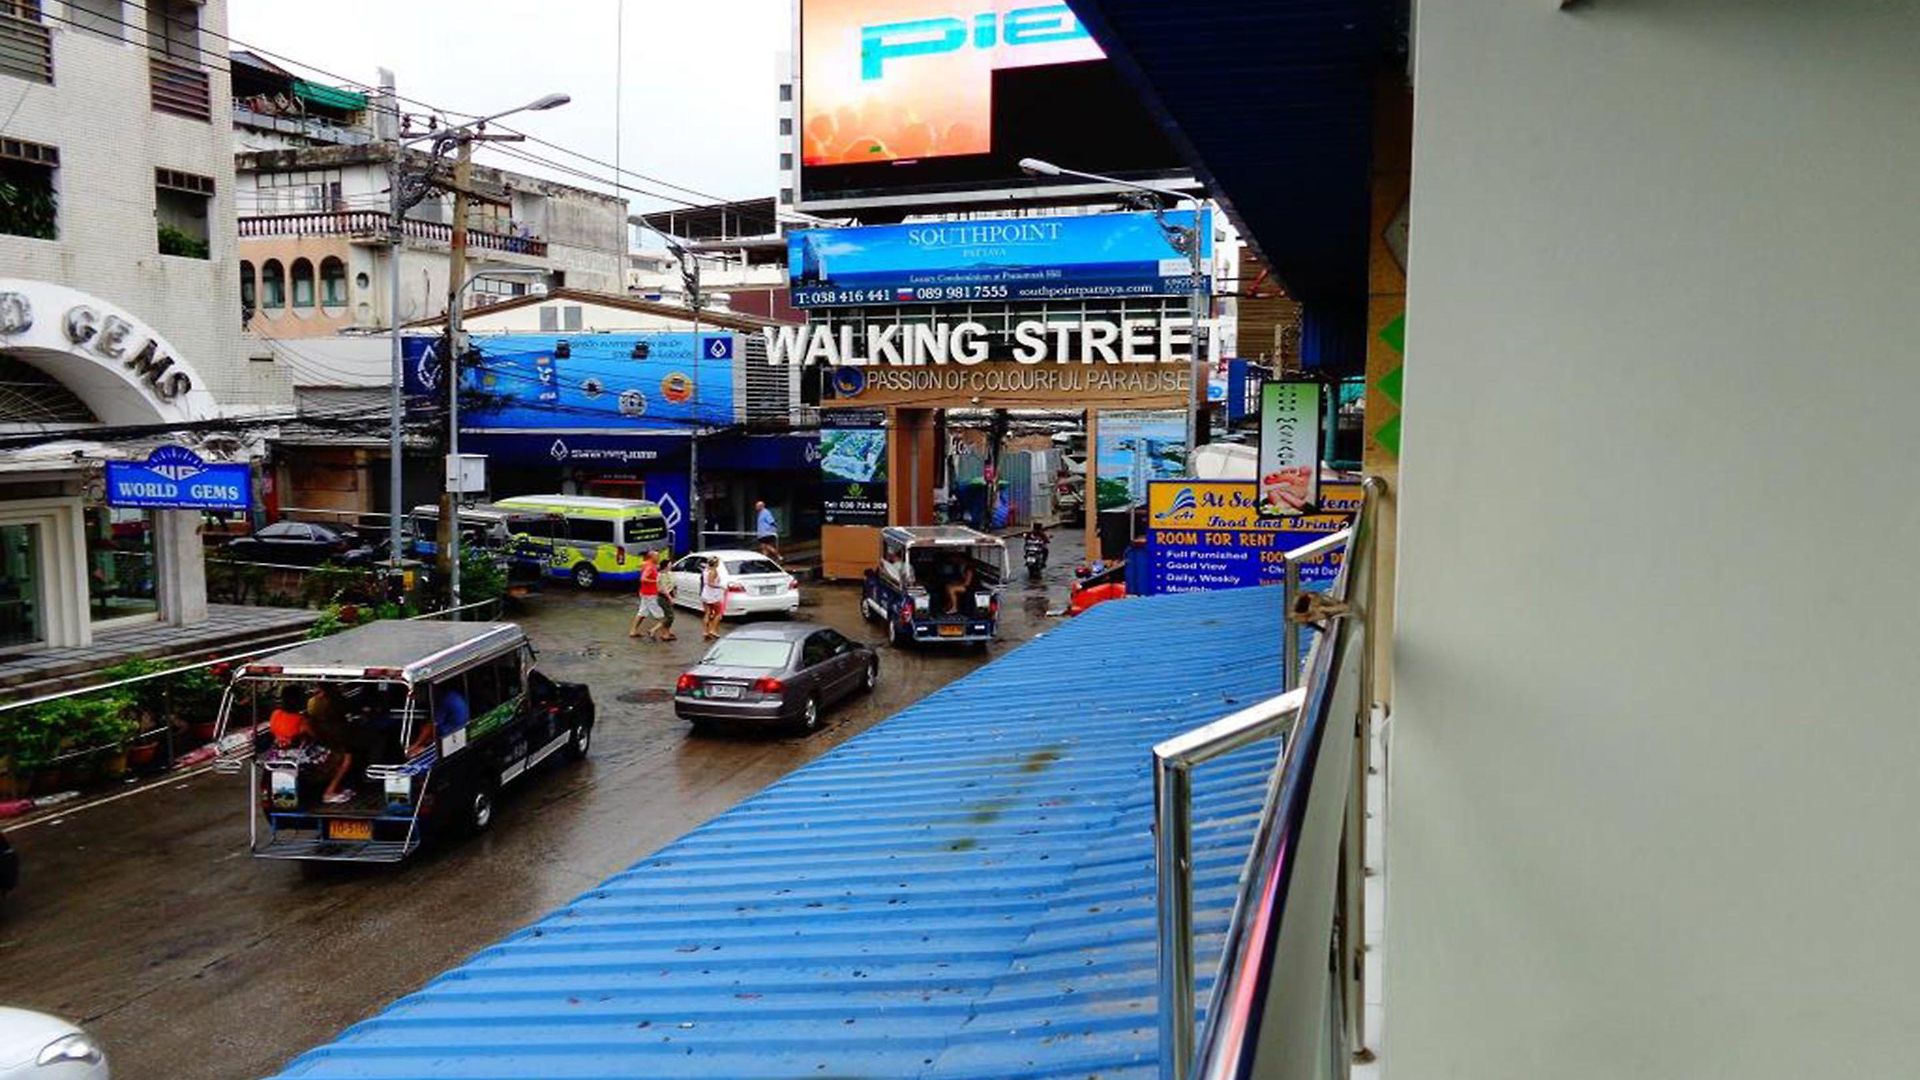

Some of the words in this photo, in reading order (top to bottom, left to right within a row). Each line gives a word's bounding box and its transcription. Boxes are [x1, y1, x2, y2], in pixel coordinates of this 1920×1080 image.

[908, 223, 1062, 246] SOUTHPOINT
[962, 248, 1006, 258] PATTAYA
[811, 291, 836, 304] 038
[839, 289, 864, 302] 416
[867, 289, 890, 301] 441
[916, 286, 942, 300] 089
[946, 286, 970, 299] 981
[974, 284, 1008, 299] 7555
[1019, 283, 1153, 298] southpointpattaya.com
[762, 322, 990, 366] WALKING
[1011, 318, 1222, 365] STREET
[62, 304, 192, 403] GEMS
[866, 370, 942, 390] PASSION
[945, 370, 968, 389] OF
[970, 369, 1082, 391] COLOURFUL
[1086, 369, 1191, 391] PARADISE
[119, 482, 178, 498] WORLD
[190, 484, 240, 501] GEMS
[1200, 490, 1225, 508] At
[1206, 515, 1248, 529] Food
[1253, 517, 1284, 529] and
[1156, 532, 1198, 545] ROOM
[1204, 533, 1232, 546] FOR
[1239, 533, 1275, 547] RENT
[1166, 550, 1187, 559] Full
[1189, 551, 1249, 560] Furnished
[1166, 561, 1197, 570] Good
[1199, 562, 1228, 571] View
[1199, 575, 1240, 585] Weekly
